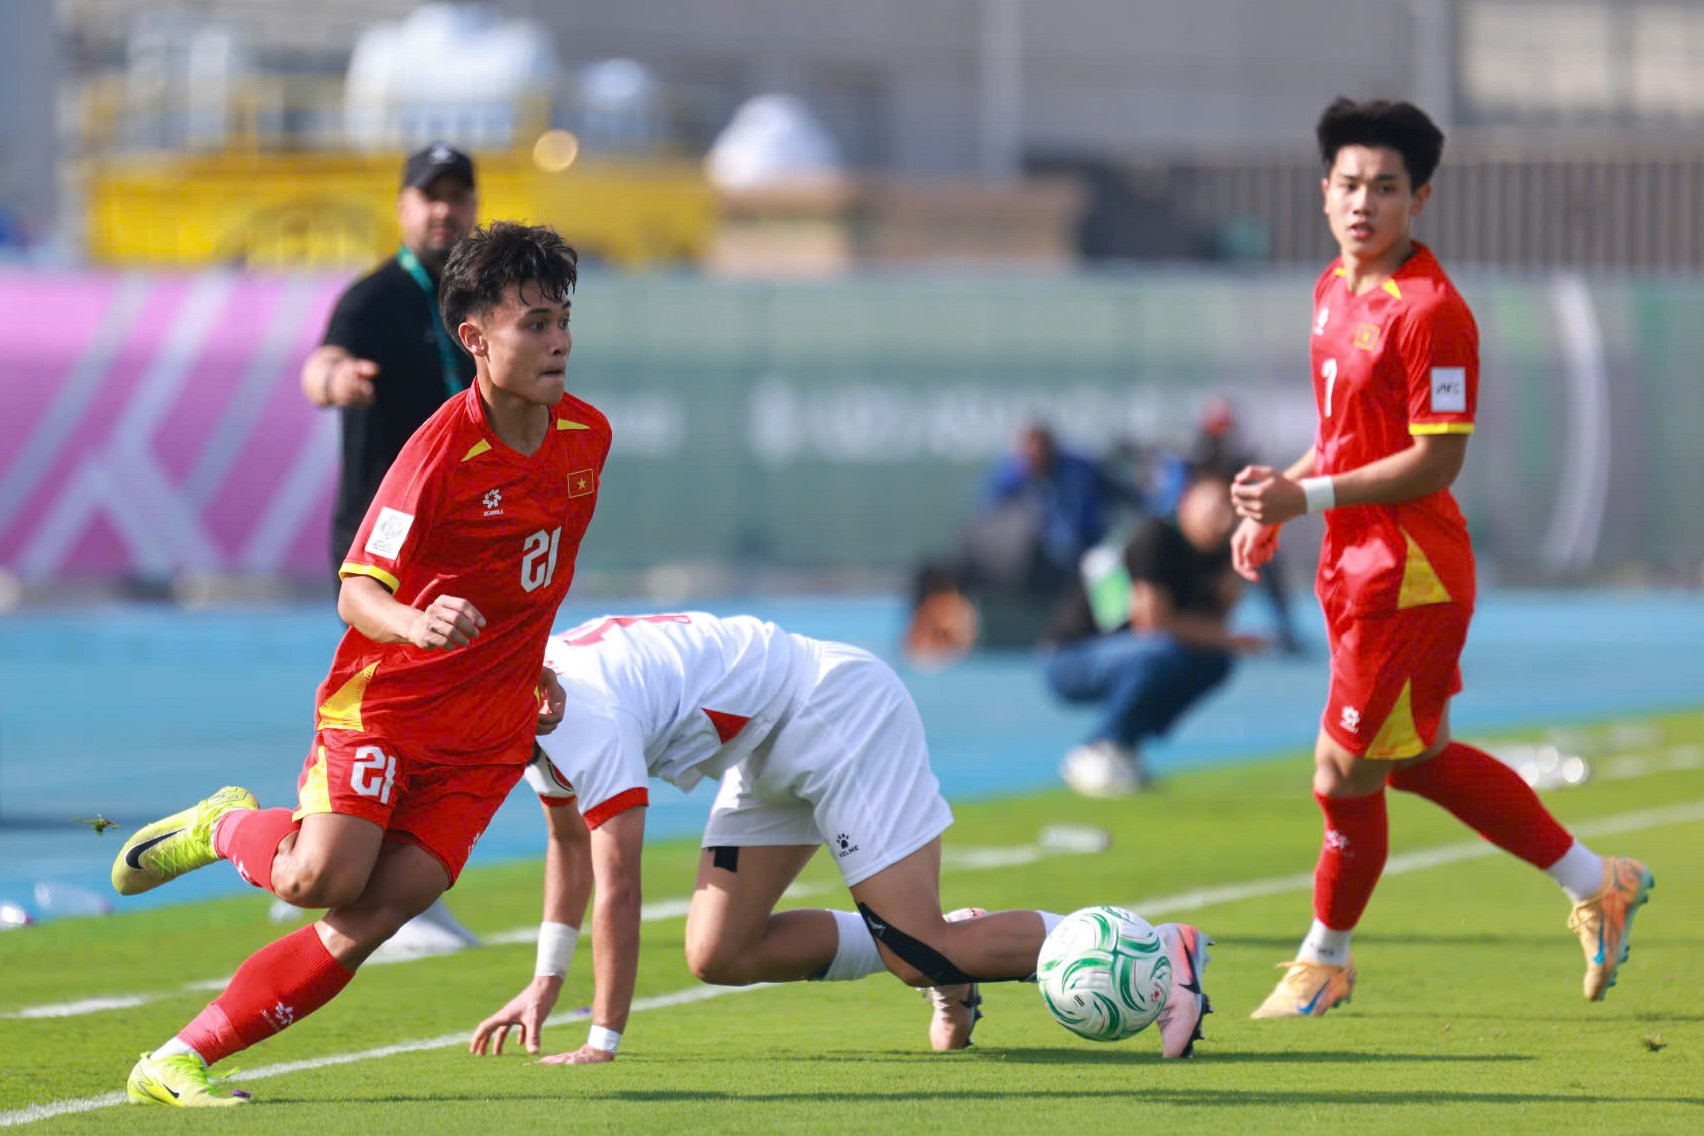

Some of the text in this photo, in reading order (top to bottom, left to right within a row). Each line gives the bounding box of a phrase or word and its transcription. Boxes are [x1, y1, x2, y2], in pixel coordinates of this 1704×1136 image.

[1321, 357, 1338, 418] 7
[520, 525, 562, 593] 21
[350, 746, 397, 805] 21
